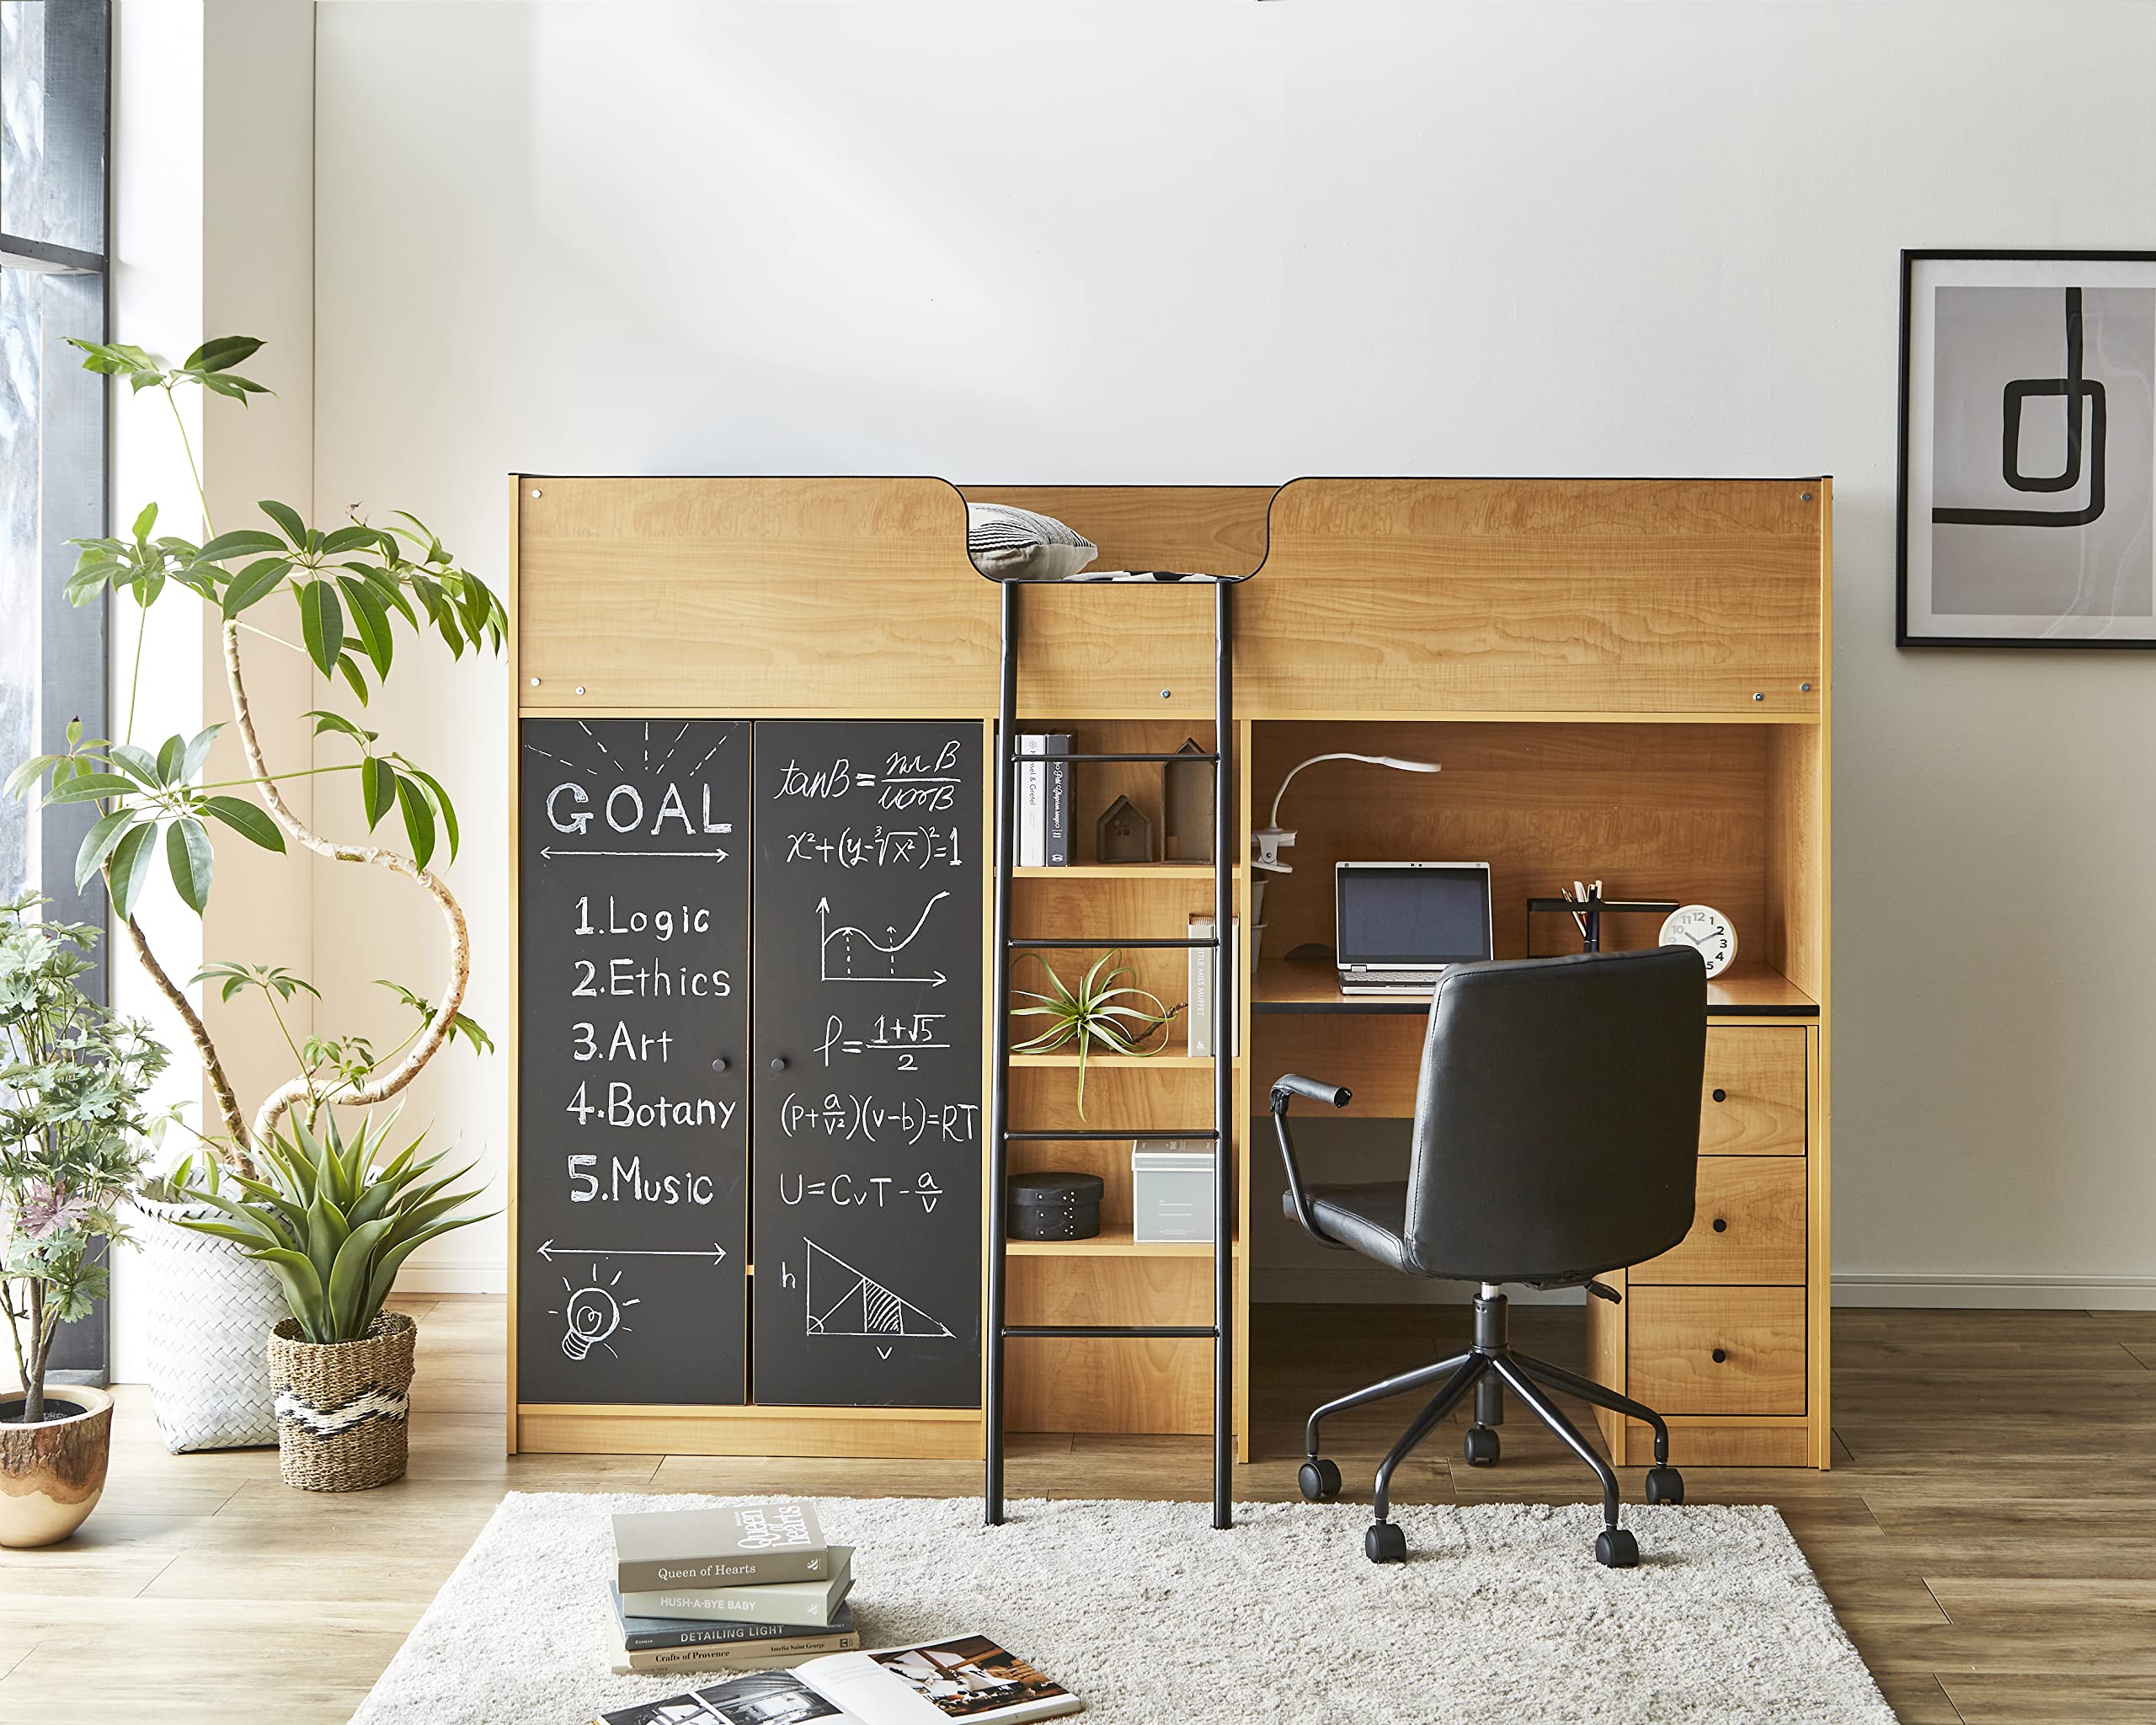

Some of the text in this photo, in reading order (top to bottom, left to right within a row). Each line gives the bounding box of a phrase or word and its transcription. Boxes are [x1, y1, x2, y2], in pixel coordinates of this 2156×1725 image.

[547, 783, 732, 835] GOAL
[1681, 916, 1691, 925] 11
[1692, 912, 1705, 921] 12
[1710, 916, 1714, 925] 1
[1672, 925, 1684, 934] 10
[1716, 926, 1724, 935] 2
[1720, 939, 1727, 948] 3
[1715, 952, 1724, 961] 4
[1706, 961, 1714, 970] 5
[782, 1262, 795, 1289] h
[738, 1509, 782, 1549] Queen
[772, 1506, 811, 1547] hearts
[658, 1564, 756, 1580] Queen of Hearts
[728, 1600, 756, 1610] BABY
[680, 1629, 744, 1642] DETAILING
[749, 1625, 784, 1637] LIGHT
[655, 1653, 680, 1663] Crafts
[692, 1651, 730, 1660] Provence
